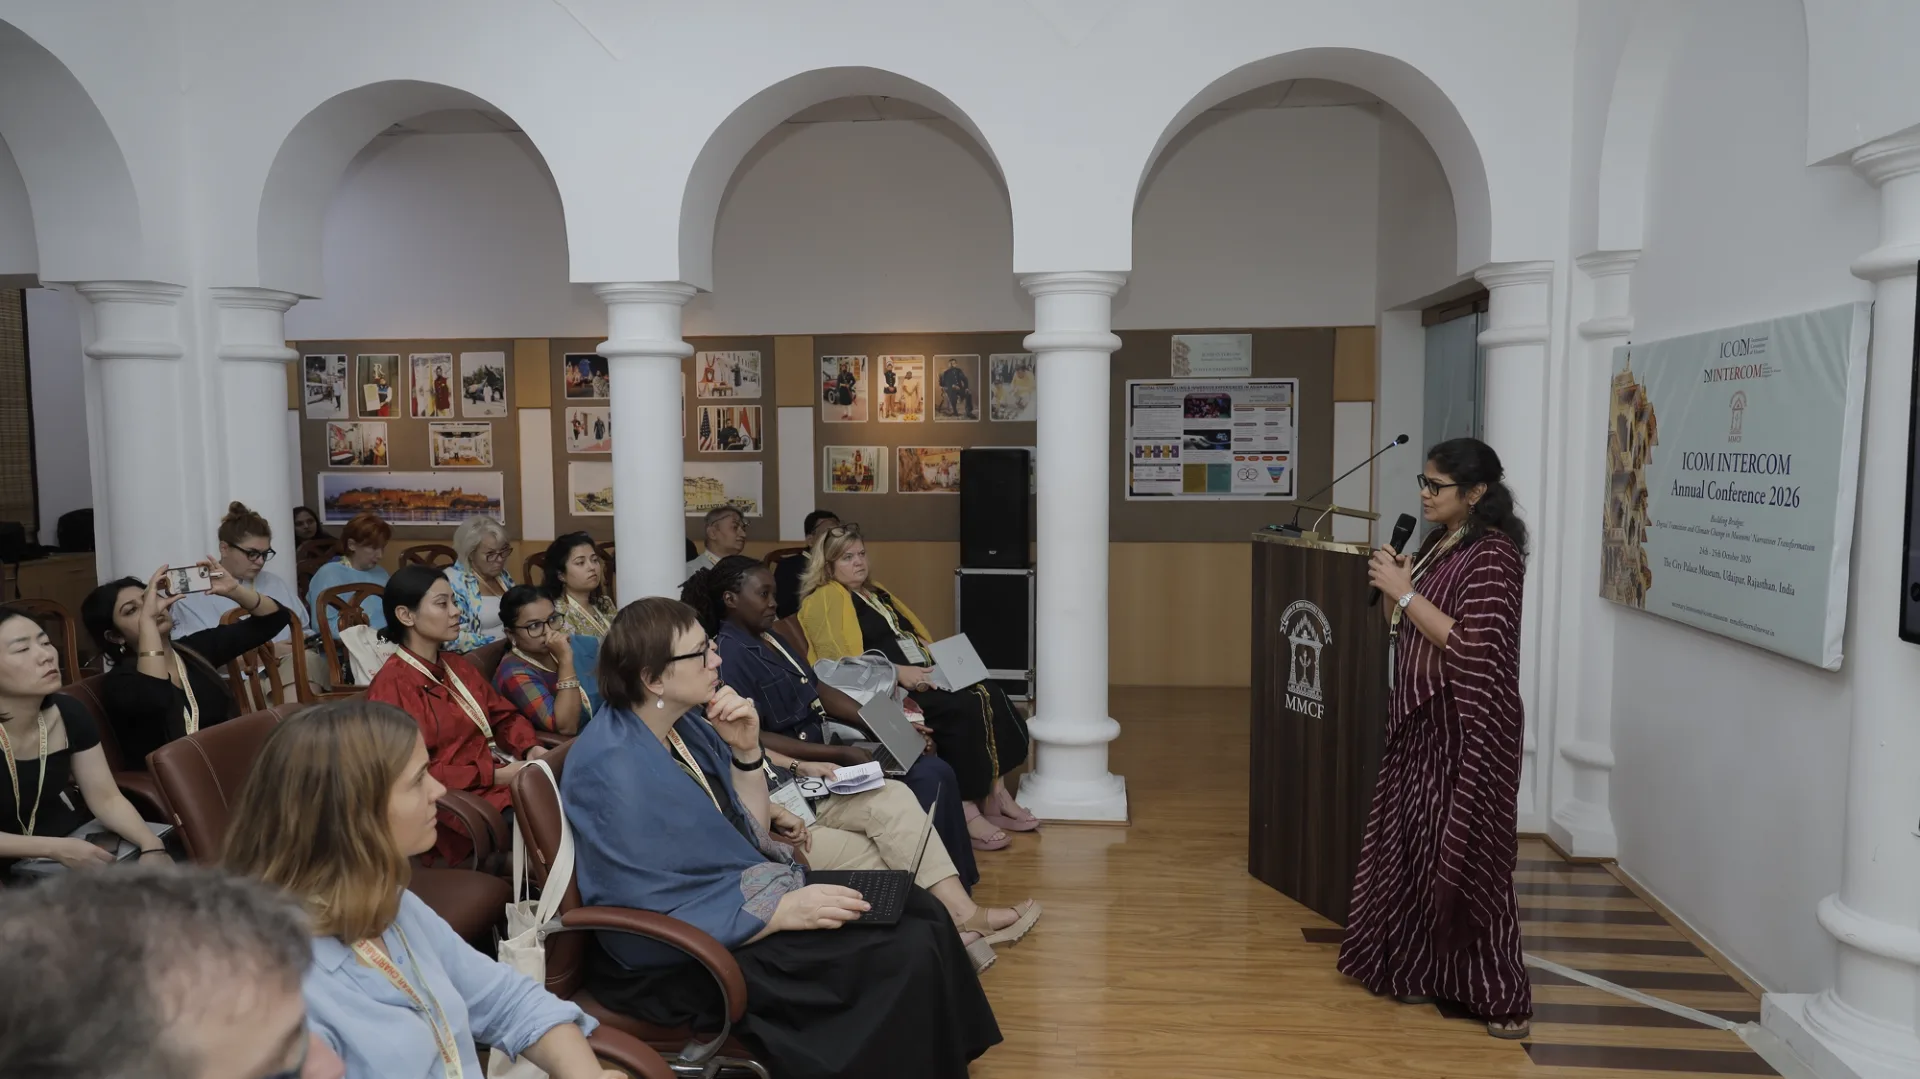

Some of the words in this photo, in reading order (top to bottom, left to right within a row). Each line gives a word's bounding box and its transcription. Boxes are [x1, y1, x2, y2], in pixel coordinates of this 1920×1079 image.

[1719, 338, 1750, 358] ICOM
[1682, 452, 1715, 471] ICOM
[1717, 453, 1792, 475] INTERCOM
[1671, 479, 1704, 499] Annual
[1707, 480, 1766, 505] Conference
[1768, 486, 1801, 508] 2026
[1721, 551, 1739, 561] October
[1777, 537, 1815, 551] Transformation
[1663, 556, 1671, 568] The
[1671, 559, 1682, 573] City
[1683, 561, 1698, 574] Palace
[1779, 582, 1796, 596] India
[1285, 693, 1325, 719] MMCF
[357, 939, 401, 980] CHARITABLE
